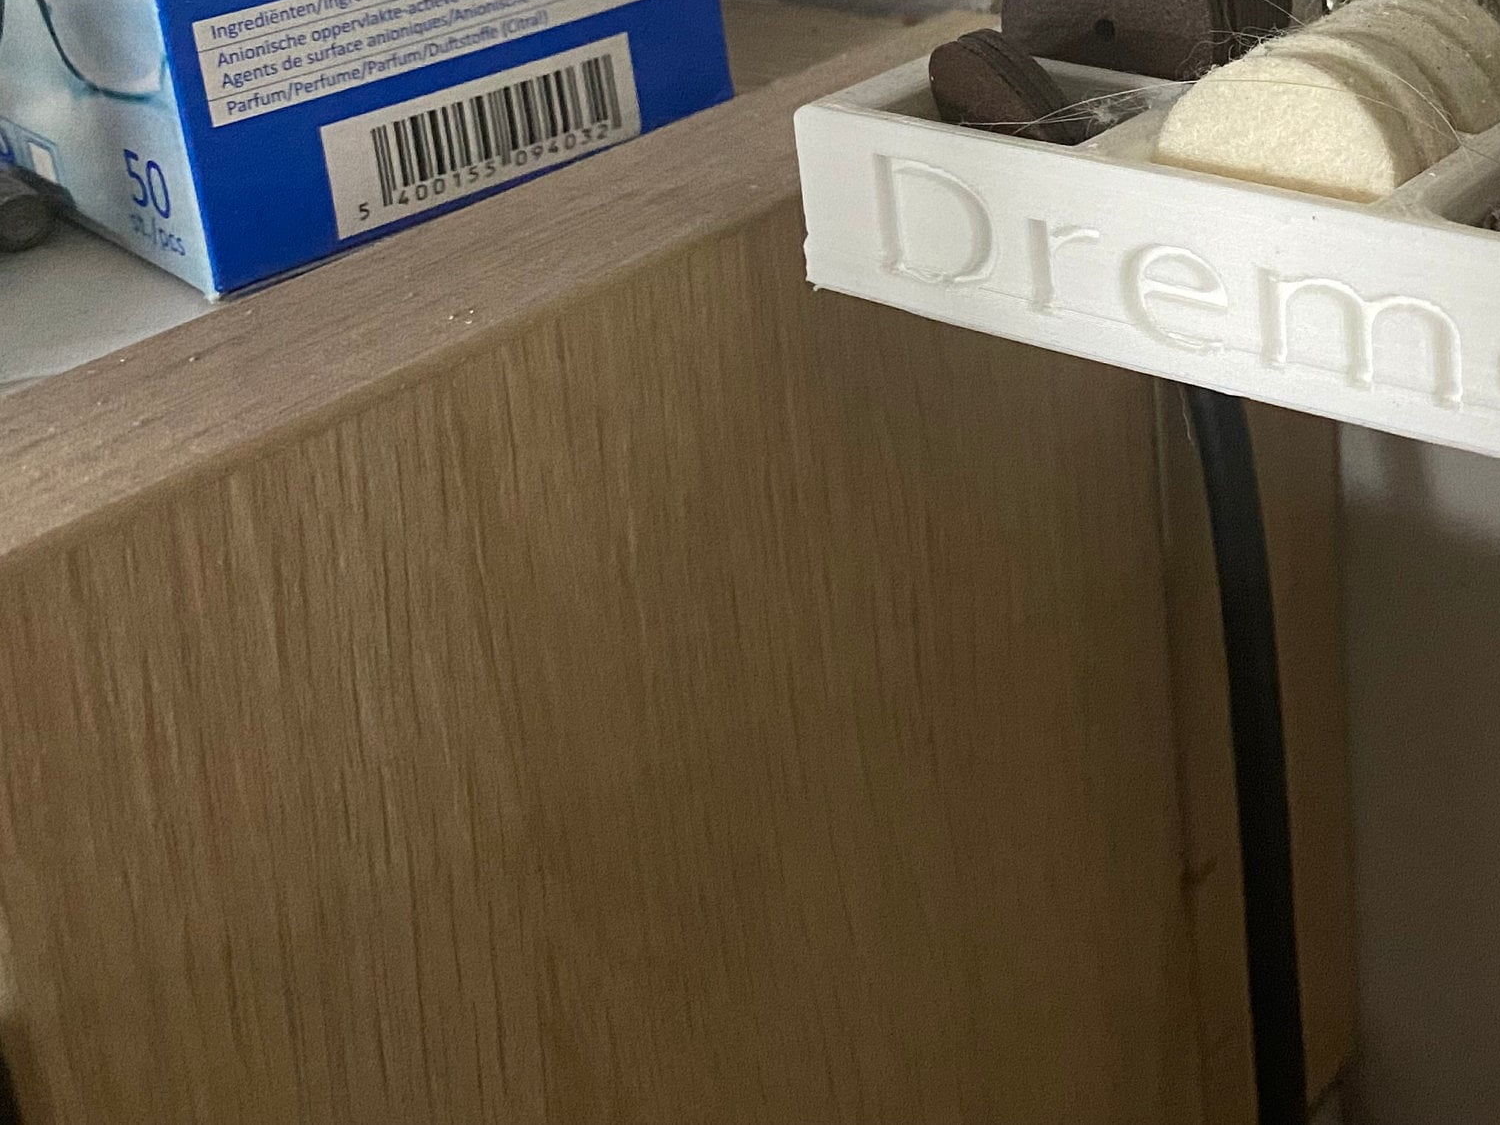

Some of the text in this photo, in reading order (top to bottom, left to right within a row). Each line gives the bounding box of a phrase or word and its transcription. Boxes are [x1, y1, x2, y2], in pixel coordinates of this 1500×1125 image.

[217, 33, 306, 67] Anionische
[222, 63, 278, 89] Agents
[283, 56, 302, 71] de
[308, 40, 363, 64] surface
[227, 26, 498, 115] Parfum/Perfume/Parfum/Duftstoffe
[124, 148, 170, 219] 50
[358, 125, 608, 221] 5 400155 094032
